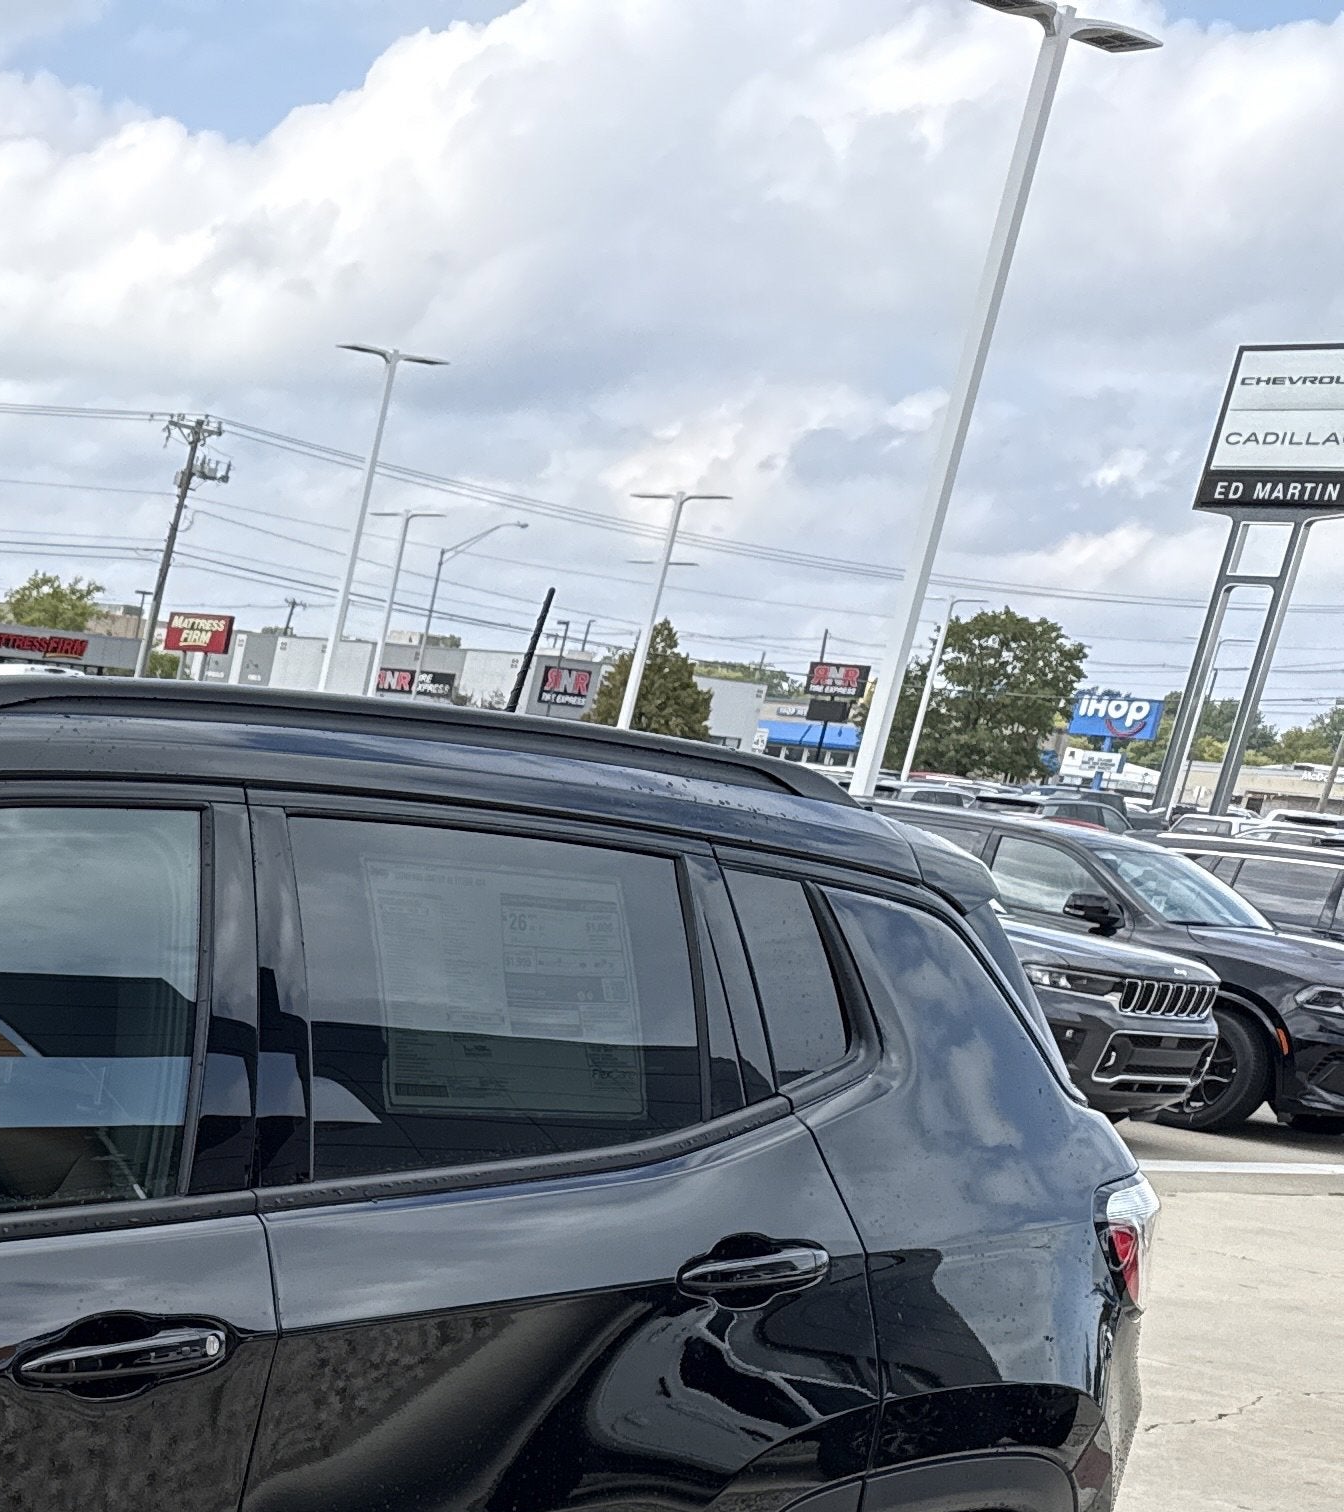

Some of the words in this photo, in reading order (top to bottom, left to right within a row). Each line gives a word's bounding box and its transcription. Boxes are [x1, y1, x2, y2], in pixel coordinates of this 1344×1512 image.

[1240, 375, 1344, 386] CHEVROL
[1225, 431, 1344, 446] CADILLA
[1213, 481, 1244, 499] ED
[1252, 481, 1341, 501] MARTIN
[171, 615, 226, 632] MATTRESS
[179, 629, 213, 644] FIRM
